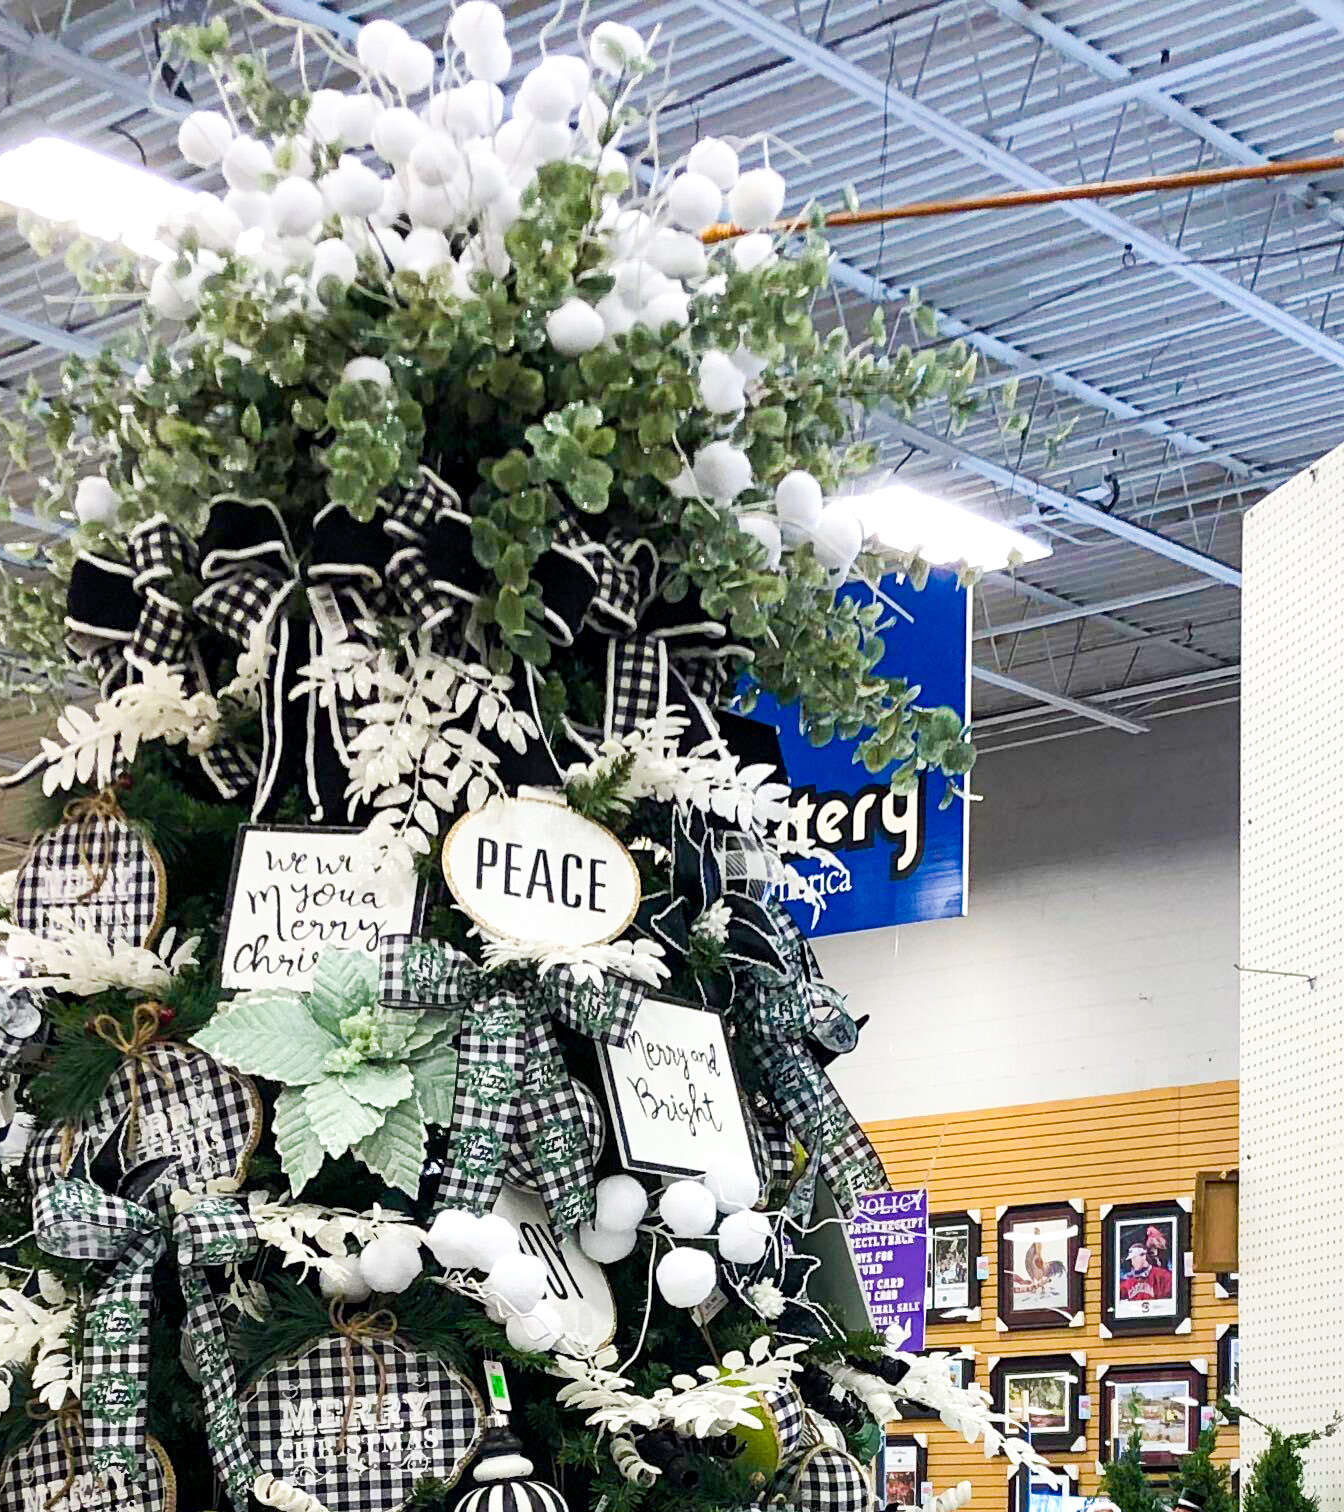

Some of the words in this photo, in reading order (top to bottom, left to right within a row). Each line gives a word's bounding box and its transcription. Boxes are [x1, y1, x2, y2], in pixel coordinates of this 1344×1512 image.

[316, 854, 354, 876] wi
[475, 836, 607, 914] PEACE
[246, 884, 388, 953] Merry
[625, 1030, 690, 1080] Merry
[690, 1042, 721, 1077] and
[626, 1076, 723, 1137] Bright
[518, 1221, 584, 1301] OY
[279, 1391, 432, 1438] MERRY
